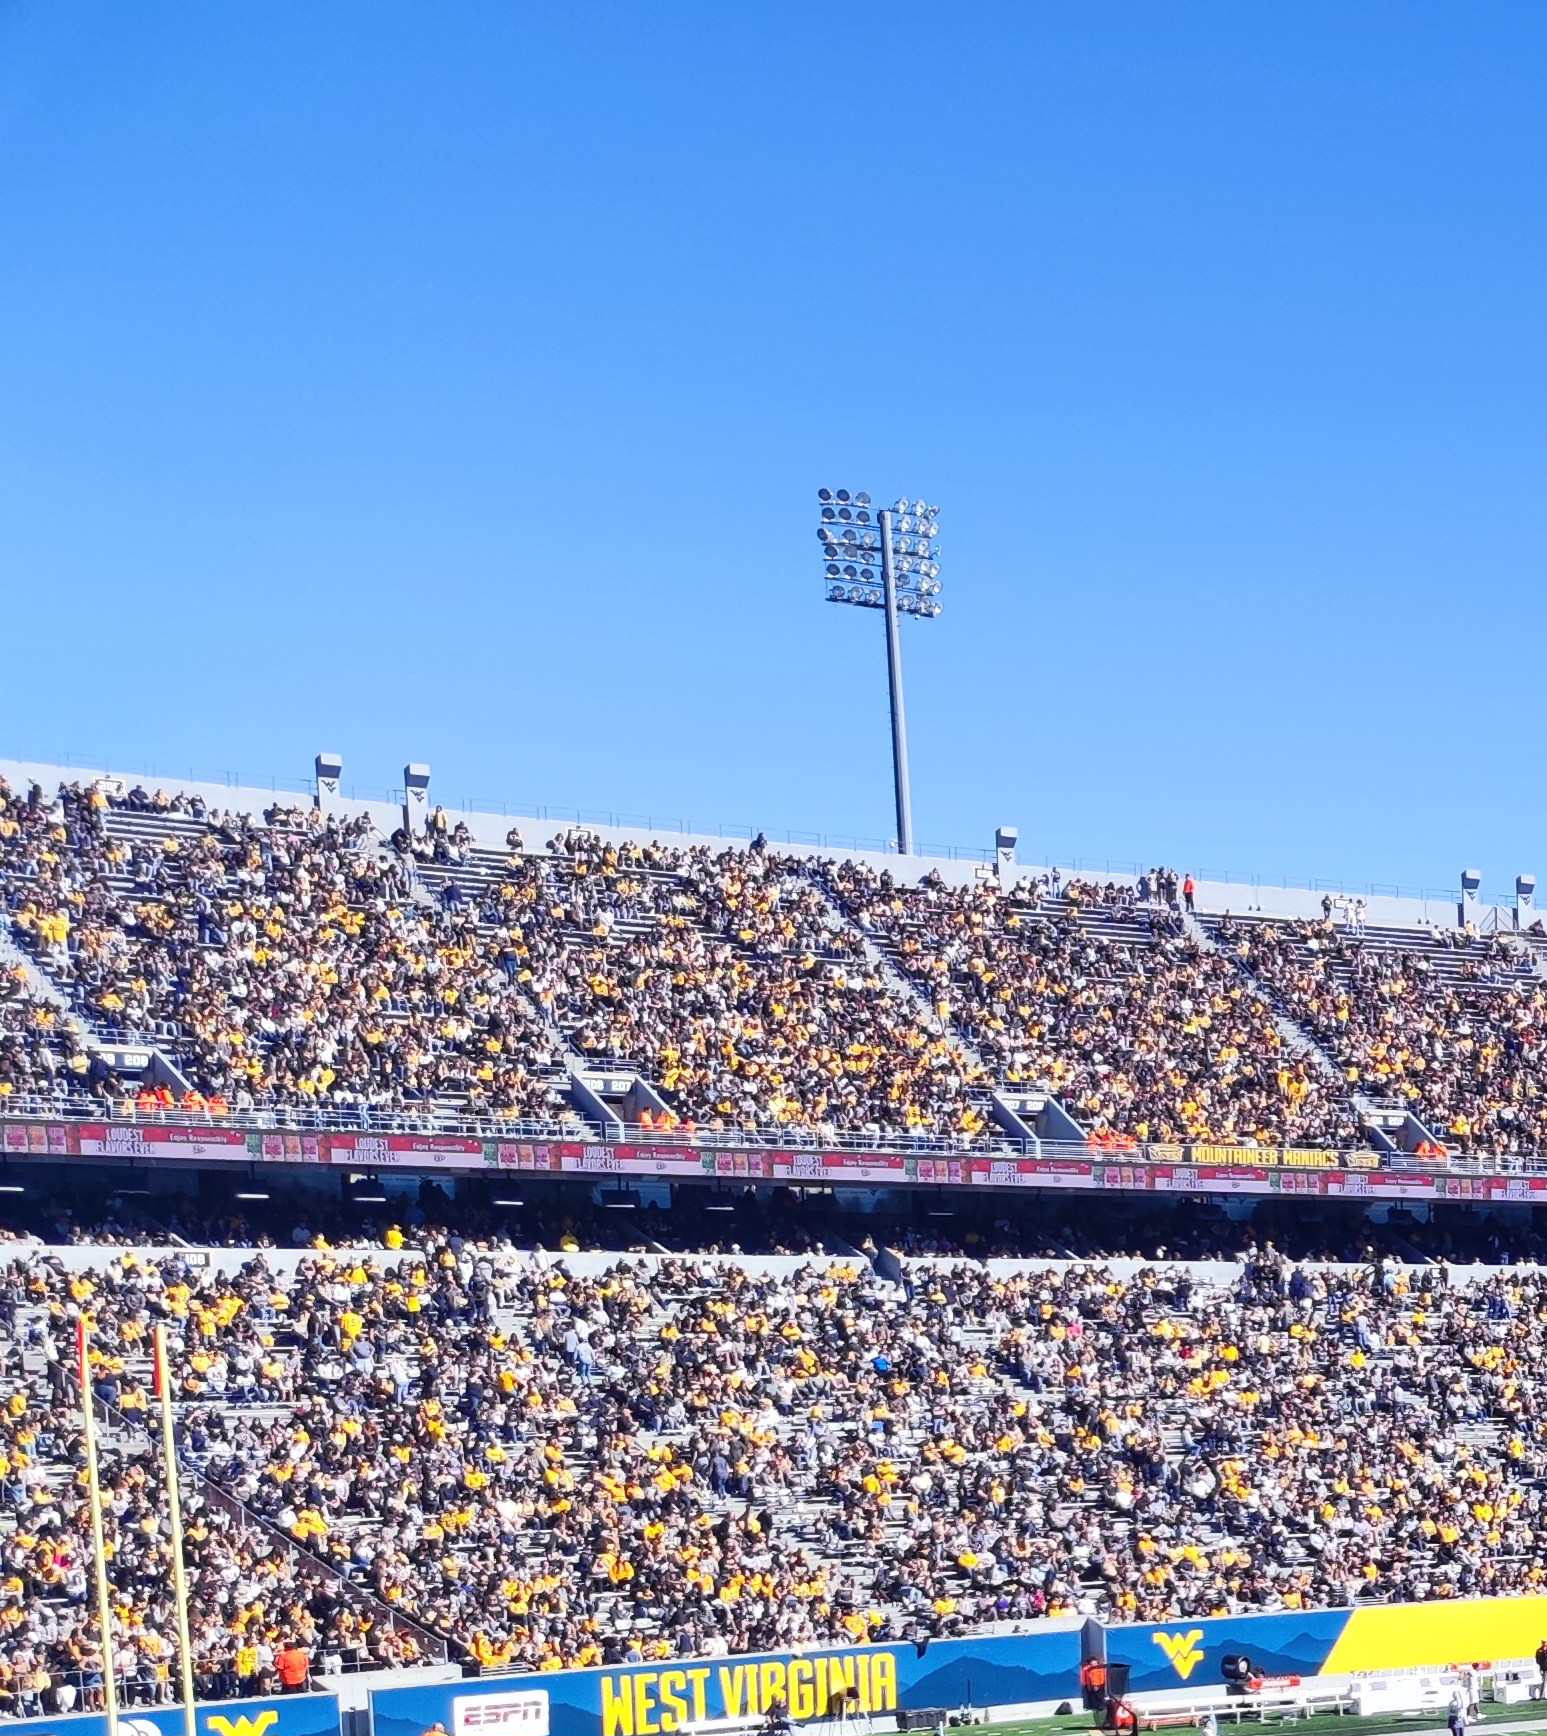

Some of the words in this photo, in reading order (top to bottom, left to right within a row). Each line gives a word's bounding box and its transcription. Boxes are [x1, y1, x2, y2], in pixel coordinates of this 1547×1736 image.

[1191, 1146, 1278, 1165] MOUNTAINEER
[1283, 1151, 1339, 1167] MANIACS
[719, 1652, 897, 1720] VIRGINIA
[464, 1700, 542, 1728] ESPN
